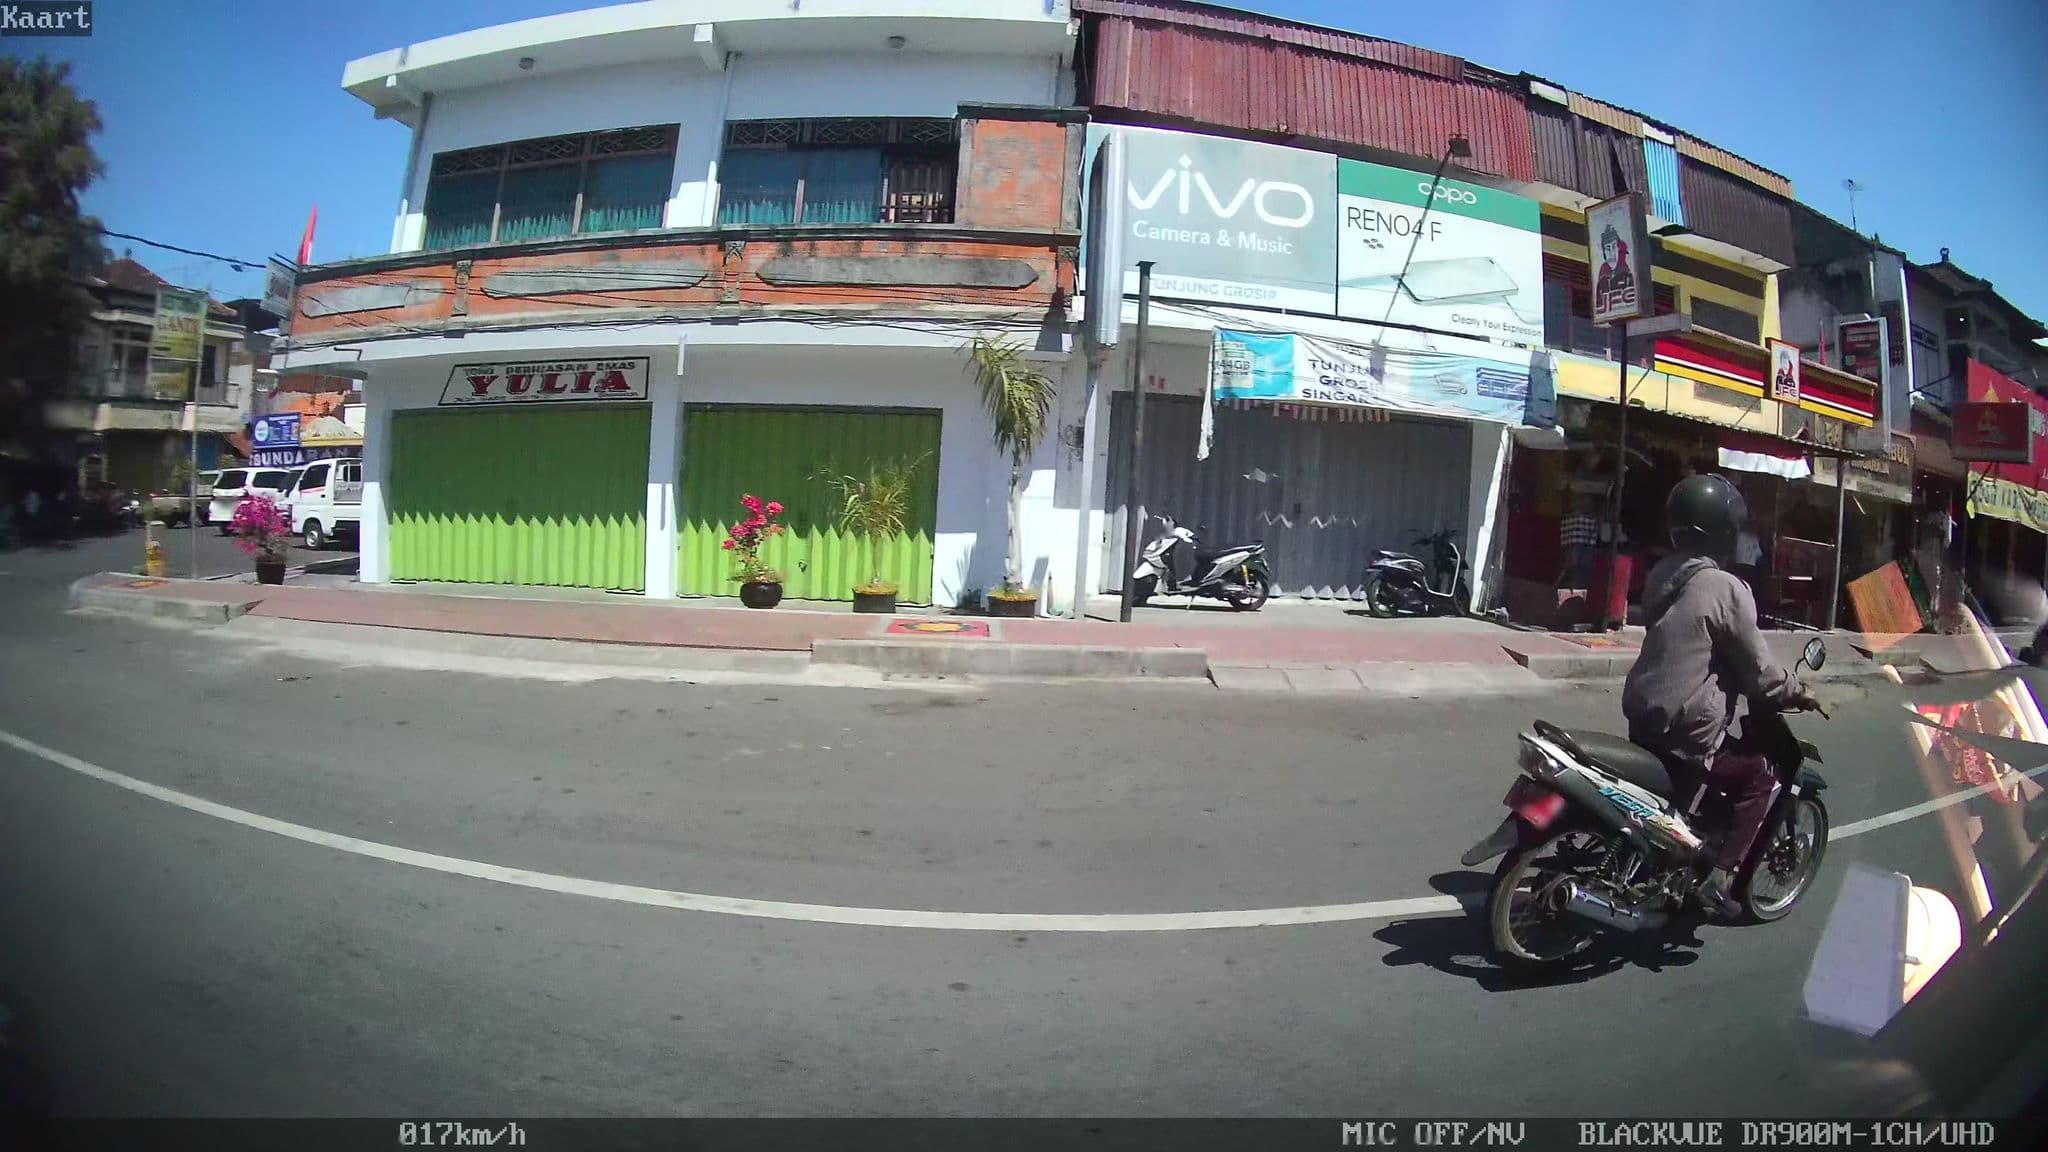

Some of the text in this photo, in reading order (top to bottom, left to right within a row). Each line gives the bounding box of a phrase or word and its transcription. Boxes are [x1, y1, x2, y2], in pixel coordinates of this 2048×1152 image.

[1127, 153, 1314, 228] vivo
[1418, 182, 1477, 205] oppo
[1132, 219, 1293, 255] Camera & Music
[1154, 278, 1219, 295] UNJUNG
[467, 370, 631, 396] YULIA
